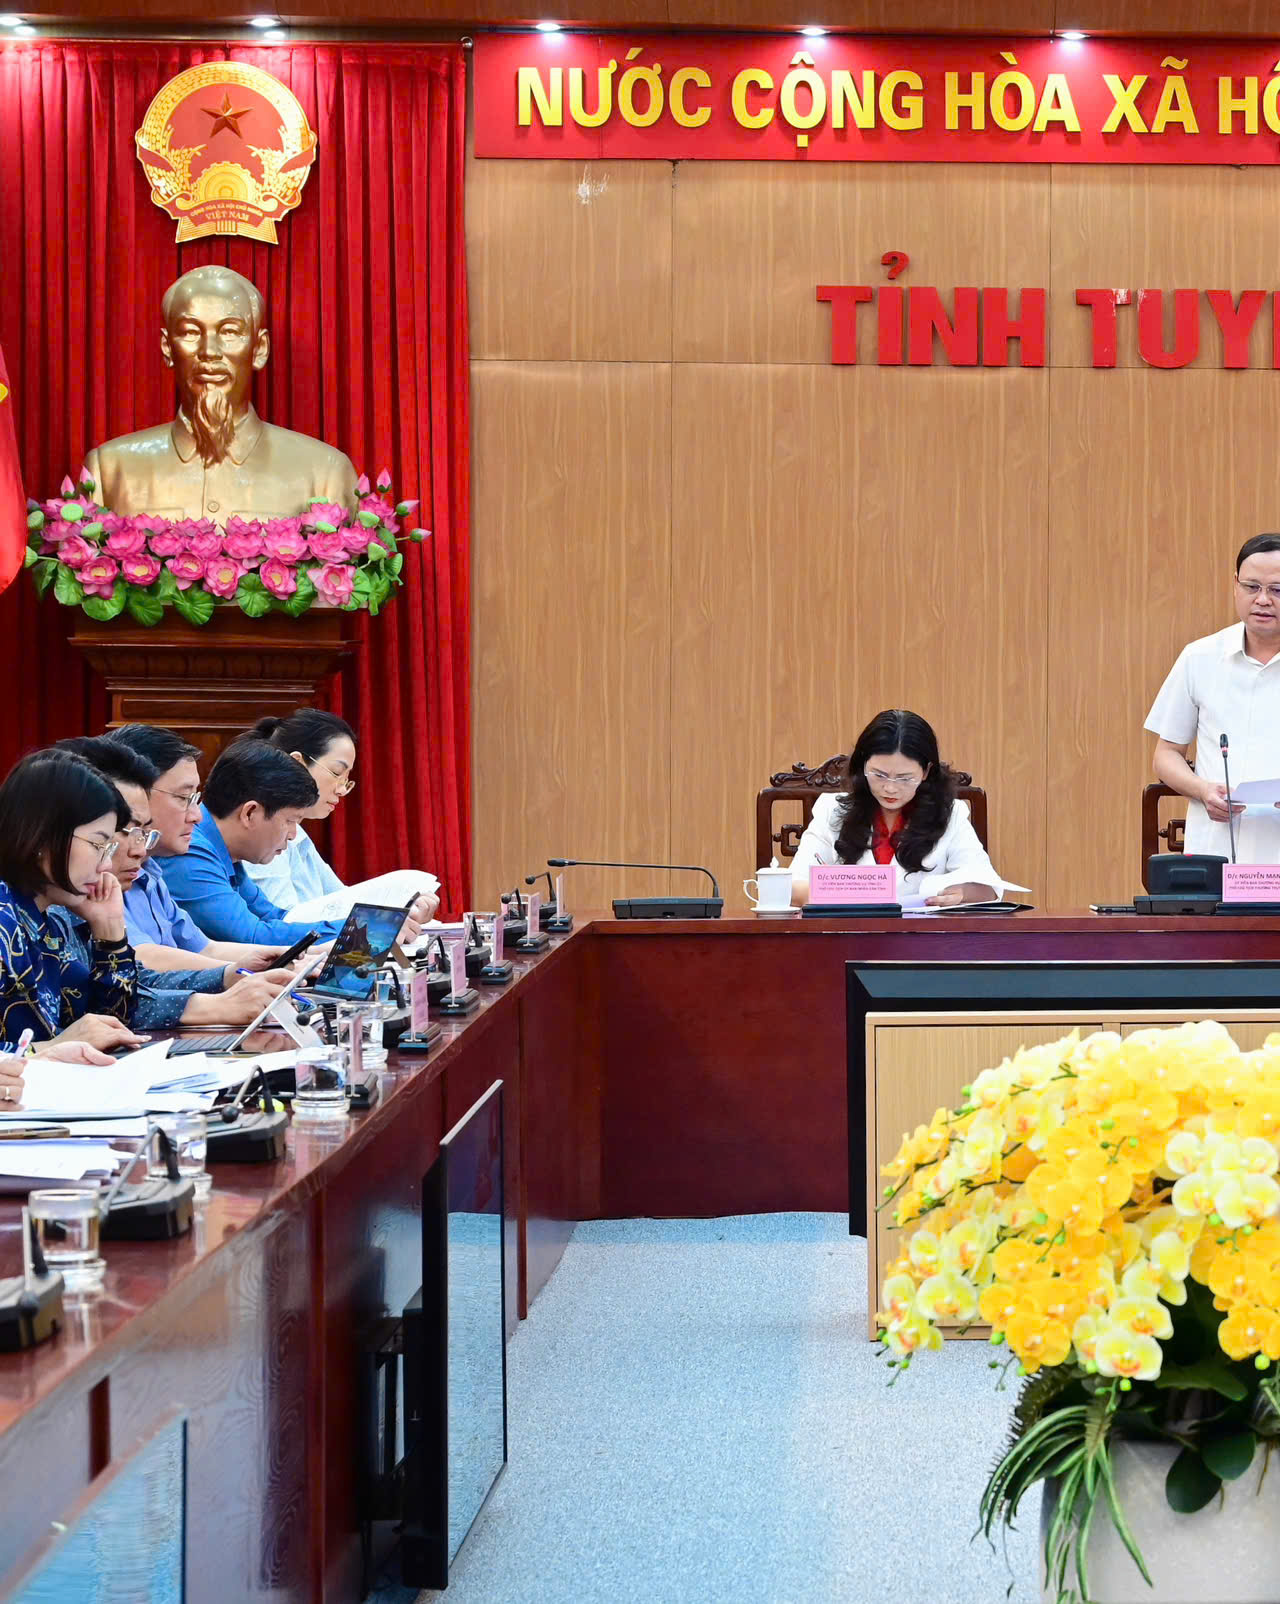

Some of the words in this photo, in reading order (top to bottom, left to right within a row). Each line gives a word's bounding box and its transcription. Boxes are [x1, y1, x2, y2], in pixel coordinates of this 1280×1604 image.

[518, 47, 713, 128] NƯỚC
[731, 51, 924, 148] CỘNG
[944, 52, 1081, 133] HÒA
[1101, 57, 1200, 135] XÃ
[815, 250, 1047, 367] TỈNH
